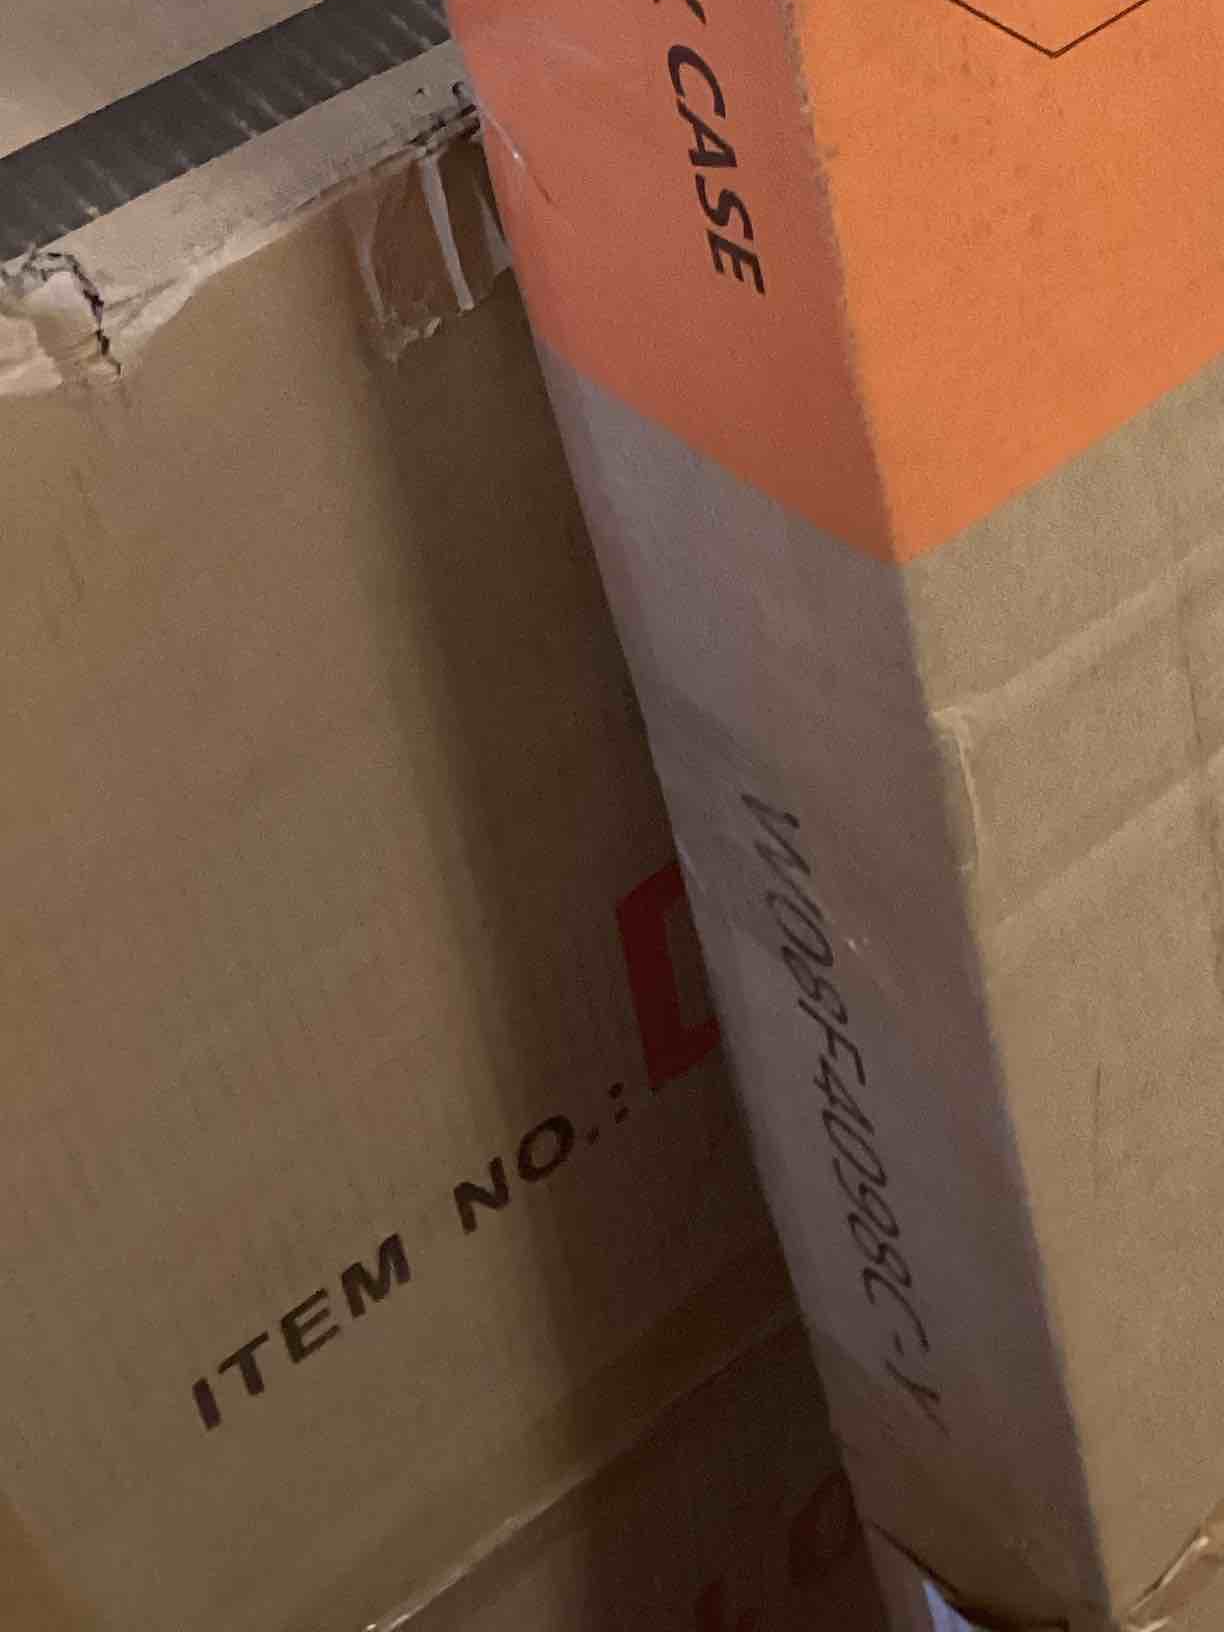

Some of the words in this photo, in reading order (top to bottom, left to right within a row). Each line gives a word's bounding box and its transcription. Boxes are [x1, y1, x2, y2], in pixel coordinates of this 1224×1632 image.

[667, 44, 766, 296] CASE
[191, 1232, 411, 1432] ITEM
[452, 1081, 629, 1236] NO.:
